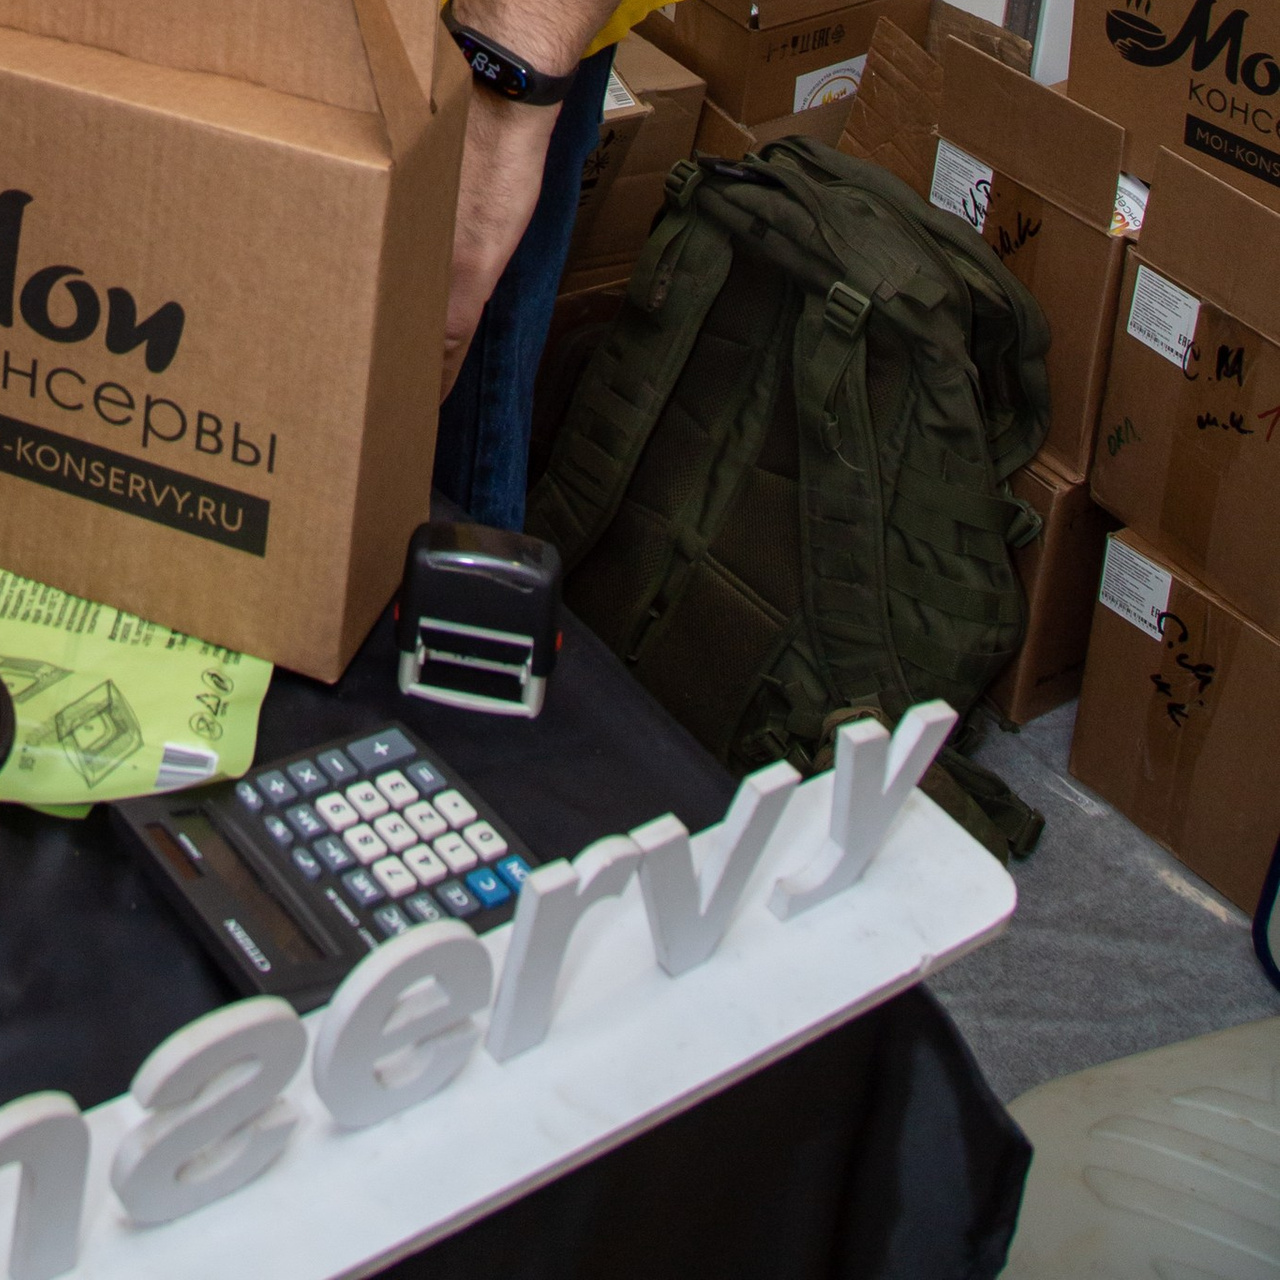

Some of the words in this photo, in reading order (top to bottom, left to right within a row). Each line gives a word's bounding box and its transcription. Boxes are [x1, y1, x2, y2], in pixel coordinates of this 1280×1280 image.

[389, 780, 406, 793] 3
[358, 791, 376, 804] 6
[329, 803, 346, 815] 9
[419, 811, 436, 823] 2
[387, 822, 404, 835] 5
[358, 835, 374, 847] 8
[417, 855, 434, 867] 4
[350, 873, 378, 899] MR
[478, 877, 497, 890] C
[445, 885, 470, 908] CE
[222, 918, 272, 972] CITIZEN
